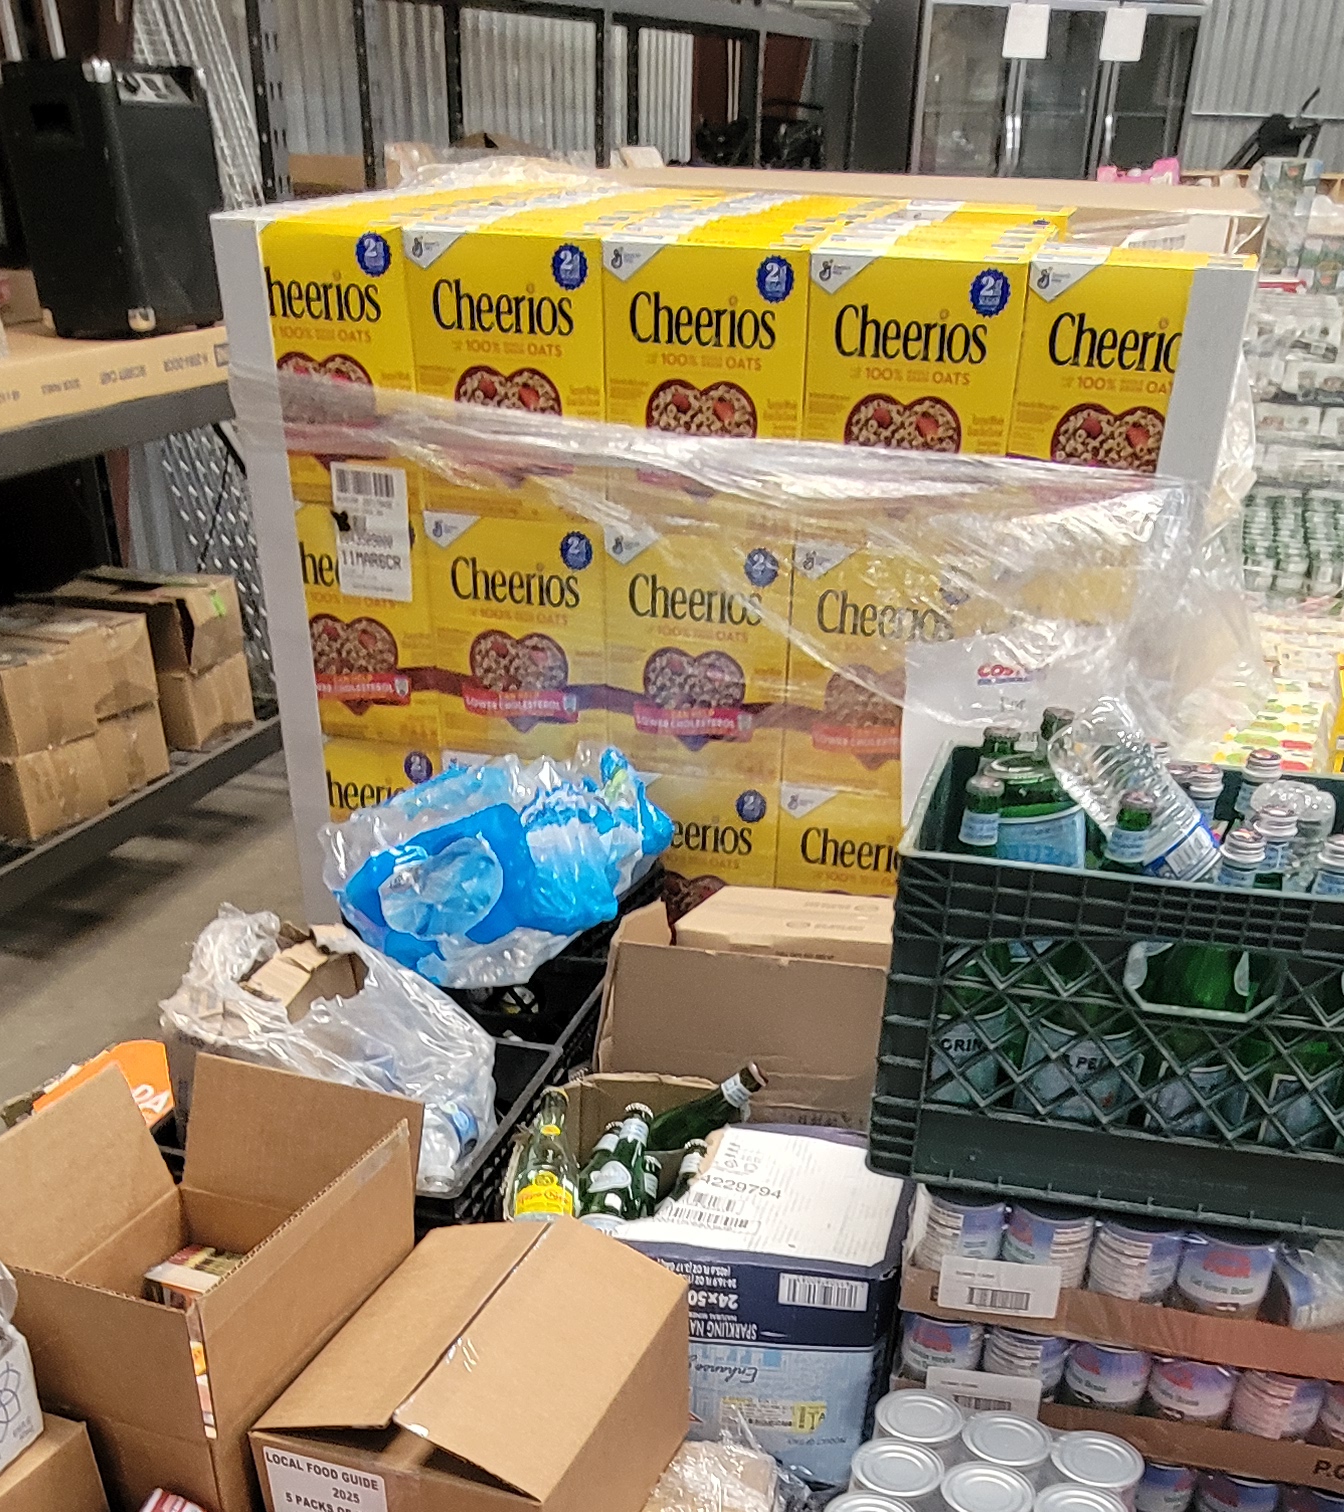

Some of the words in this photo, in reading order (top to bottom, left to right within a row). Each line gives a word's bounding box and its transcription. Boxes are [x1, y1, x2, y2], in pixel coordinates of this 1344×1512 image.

[265, 266, 383, 323] heerios
[432, 278, 574, 337] Cheerios
[629, 290, 777, 350] Cheerios
[834, 303, 988, 365] Cheerios
[338, 330, 372, 344] OATS
[528, 343, 563, 358] OATS
[725, 355, 763, 372] OATS
[932, 370, 971, 386] OATS
[450, 555, 580, 609] Cheerios
[670, 815, 753, 856] eerios
[707, 1319, 758, 1340] SPARKLING
[265, 1452, 305, 1472] LOCAL
[306, 1462, 339, 1480] FOOD
[341, 1472, 380, 1491] GUIDE
[285, 1492, 293, 1503] 5
[332, 1487, 361, 1504] 2025
